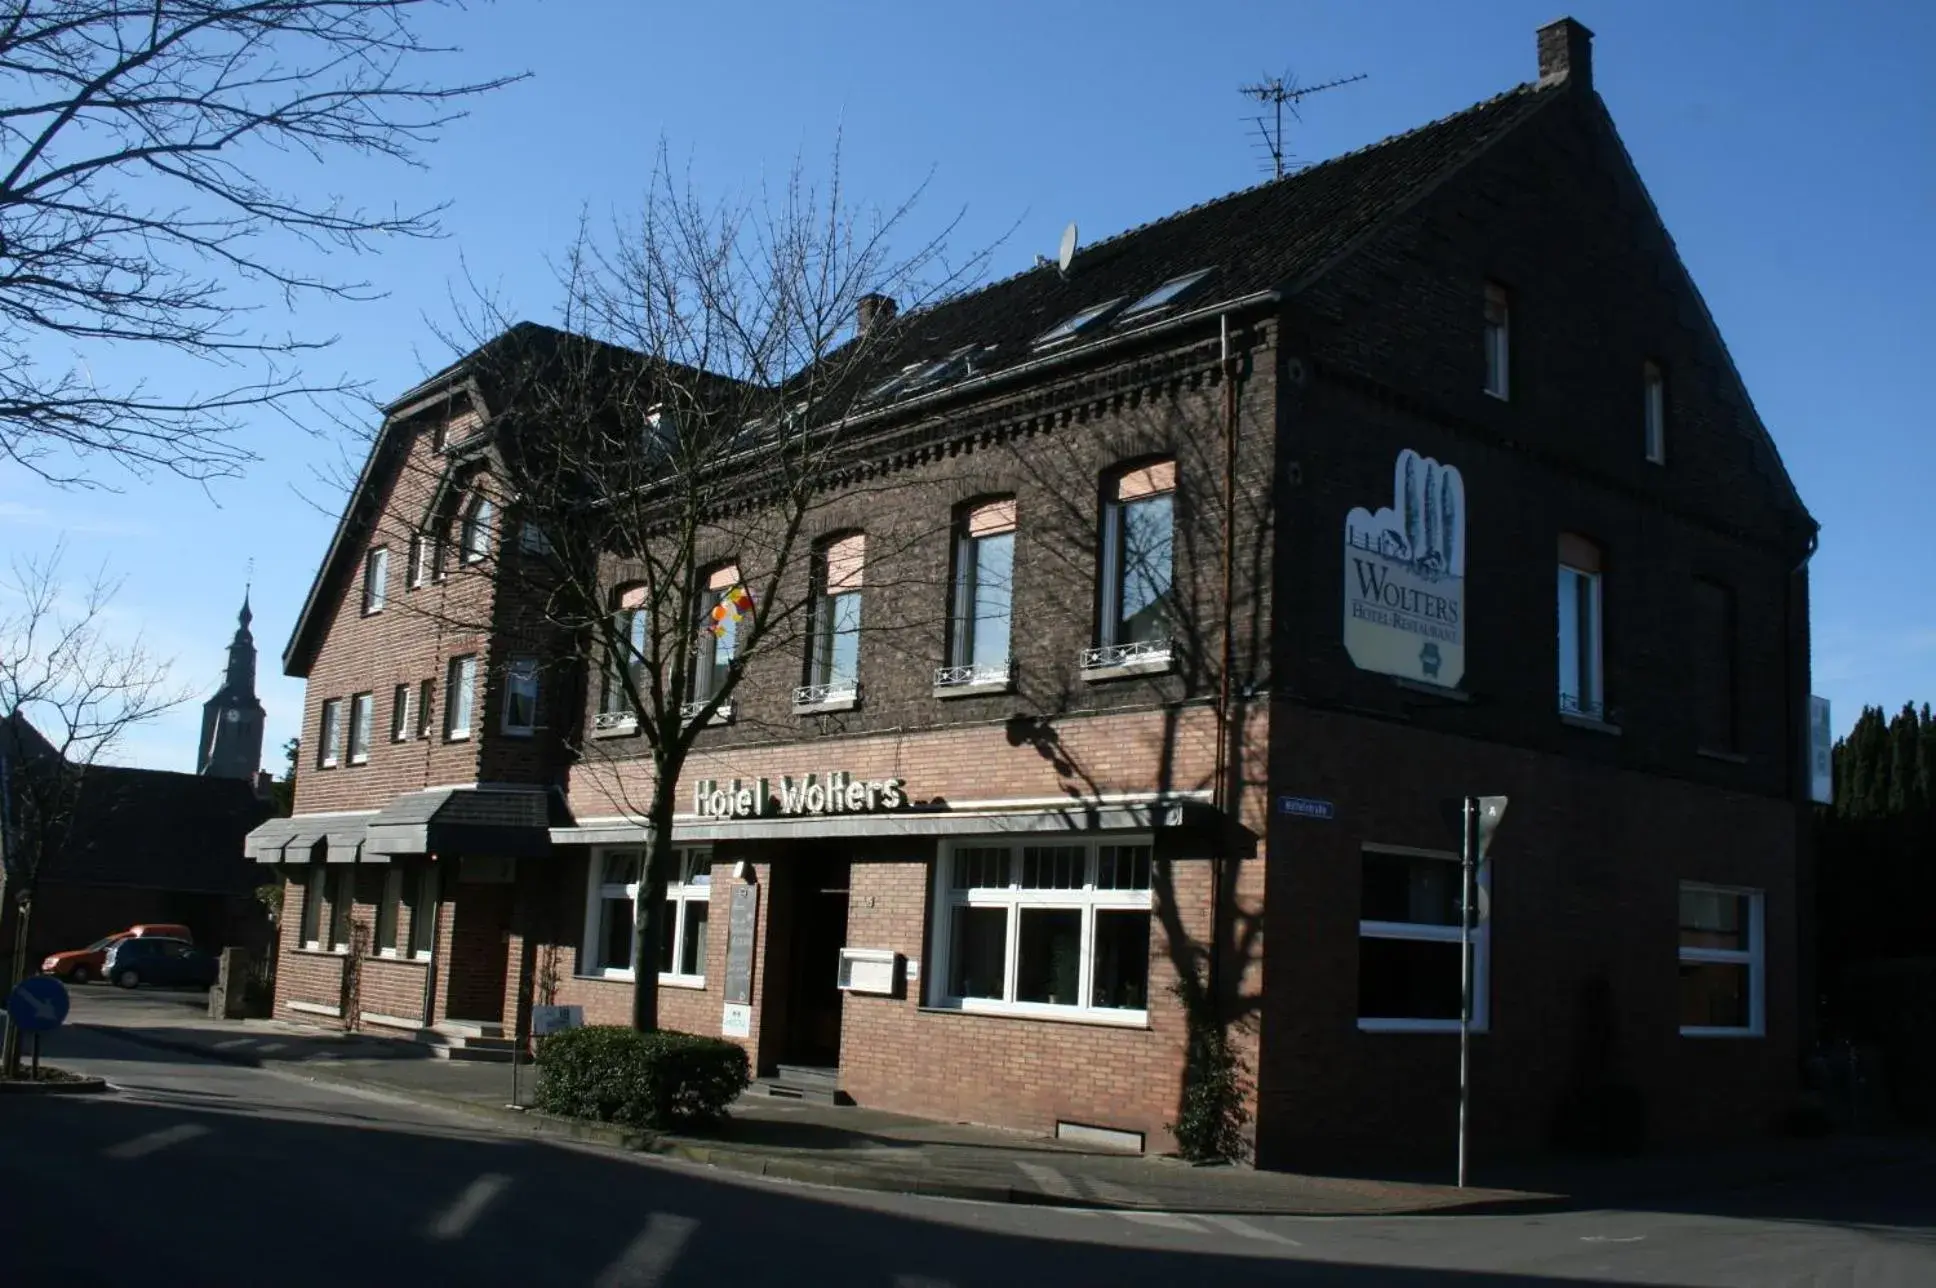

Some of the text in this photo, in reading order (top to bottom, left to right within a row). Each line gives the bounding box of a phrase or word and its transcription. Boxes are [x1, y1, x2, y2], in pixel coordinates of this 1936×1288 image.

[1354, 559, 1458, 624] WOLTERS
[694, 772, 902, 817] Hotel Wolters
